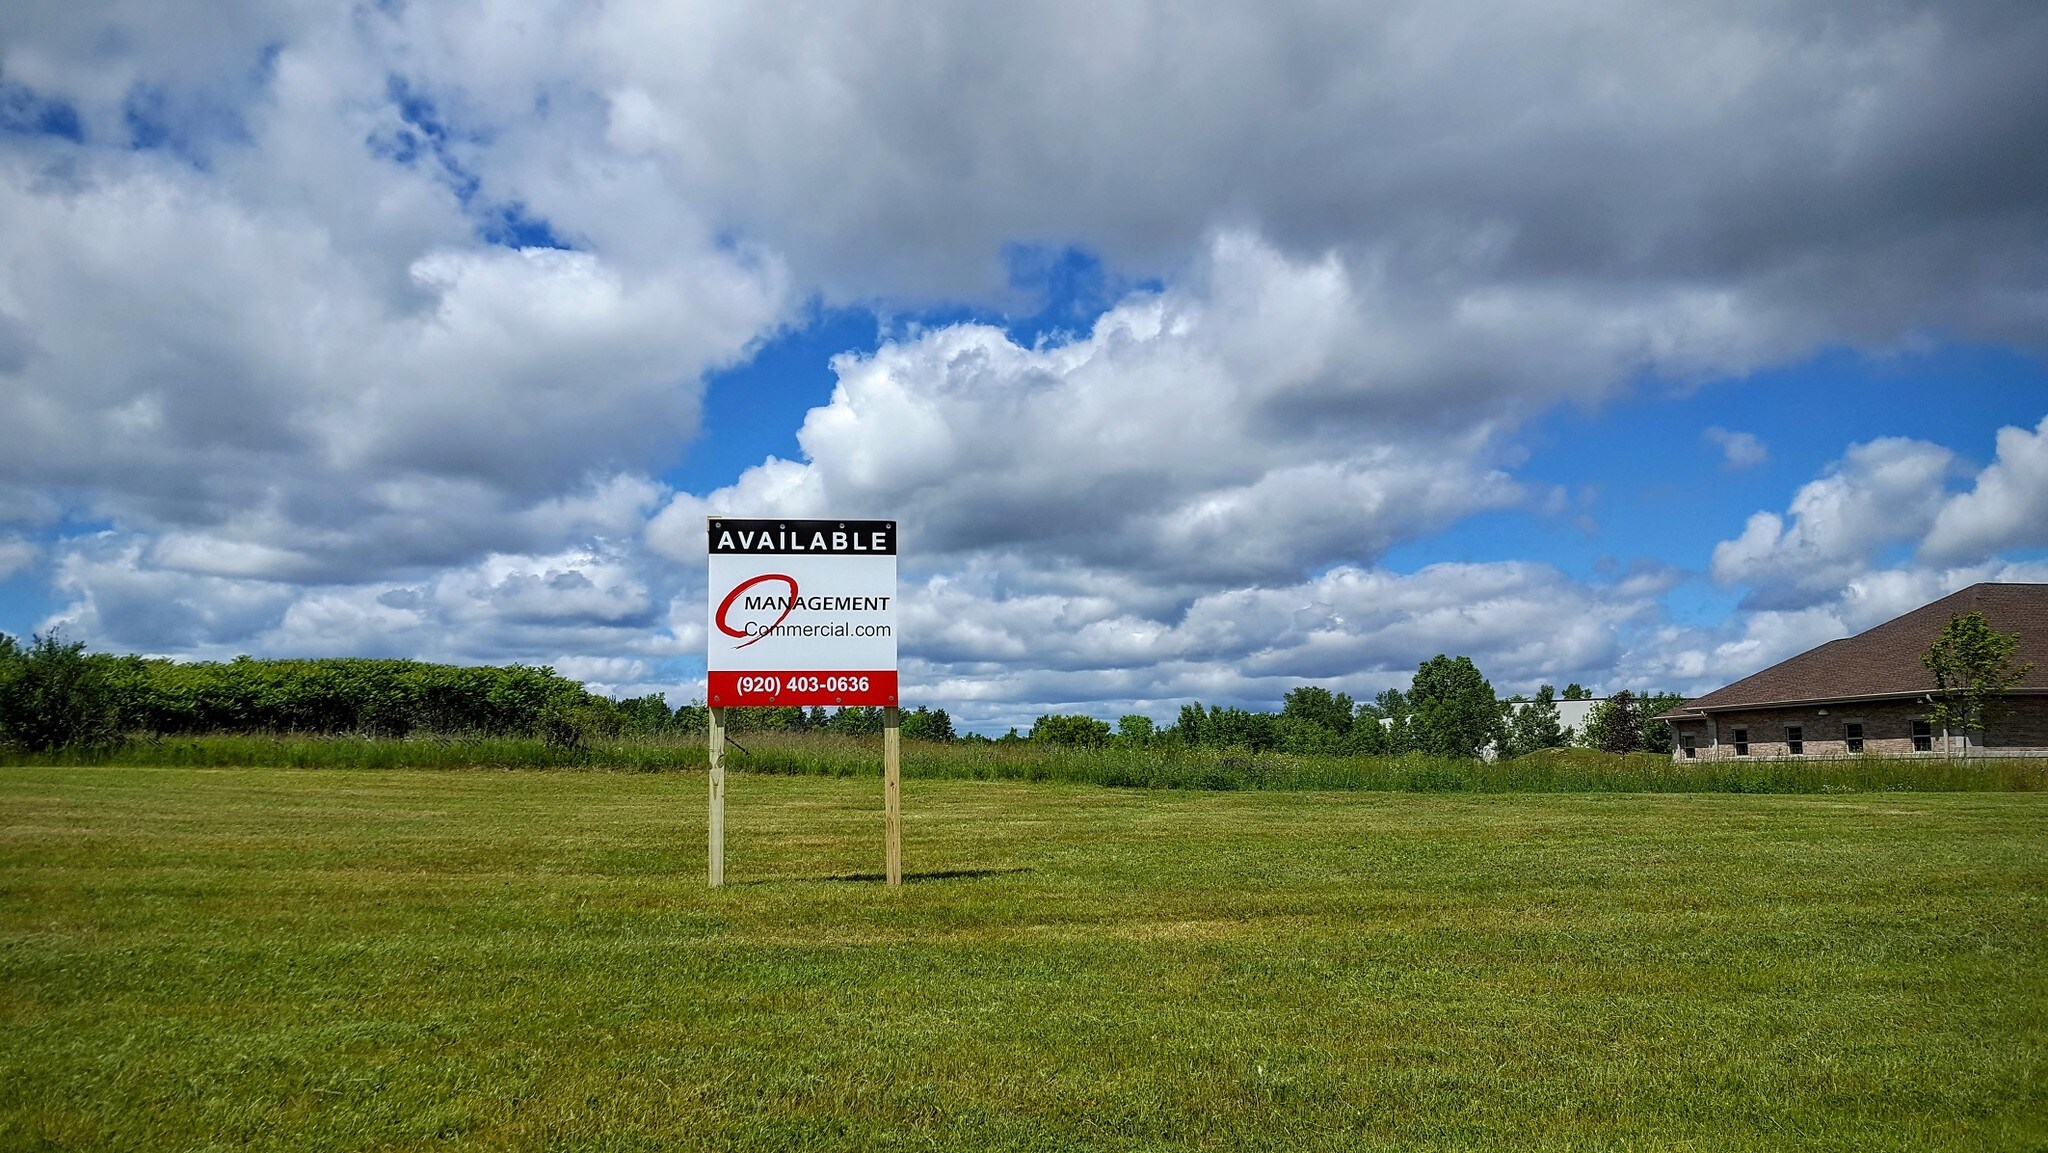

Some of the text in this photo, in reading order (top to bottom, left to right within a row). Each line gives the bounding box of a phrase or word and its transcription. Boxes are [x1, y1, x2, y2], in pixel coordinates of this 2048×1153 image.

[717, 531, 887, 550] AVAILABLE
[744, 596, 890, 611] MANAGEMENT
[744, 621, 891, 637] Commercial.com
[736, 676, 870, 696] (920) 403-0636
